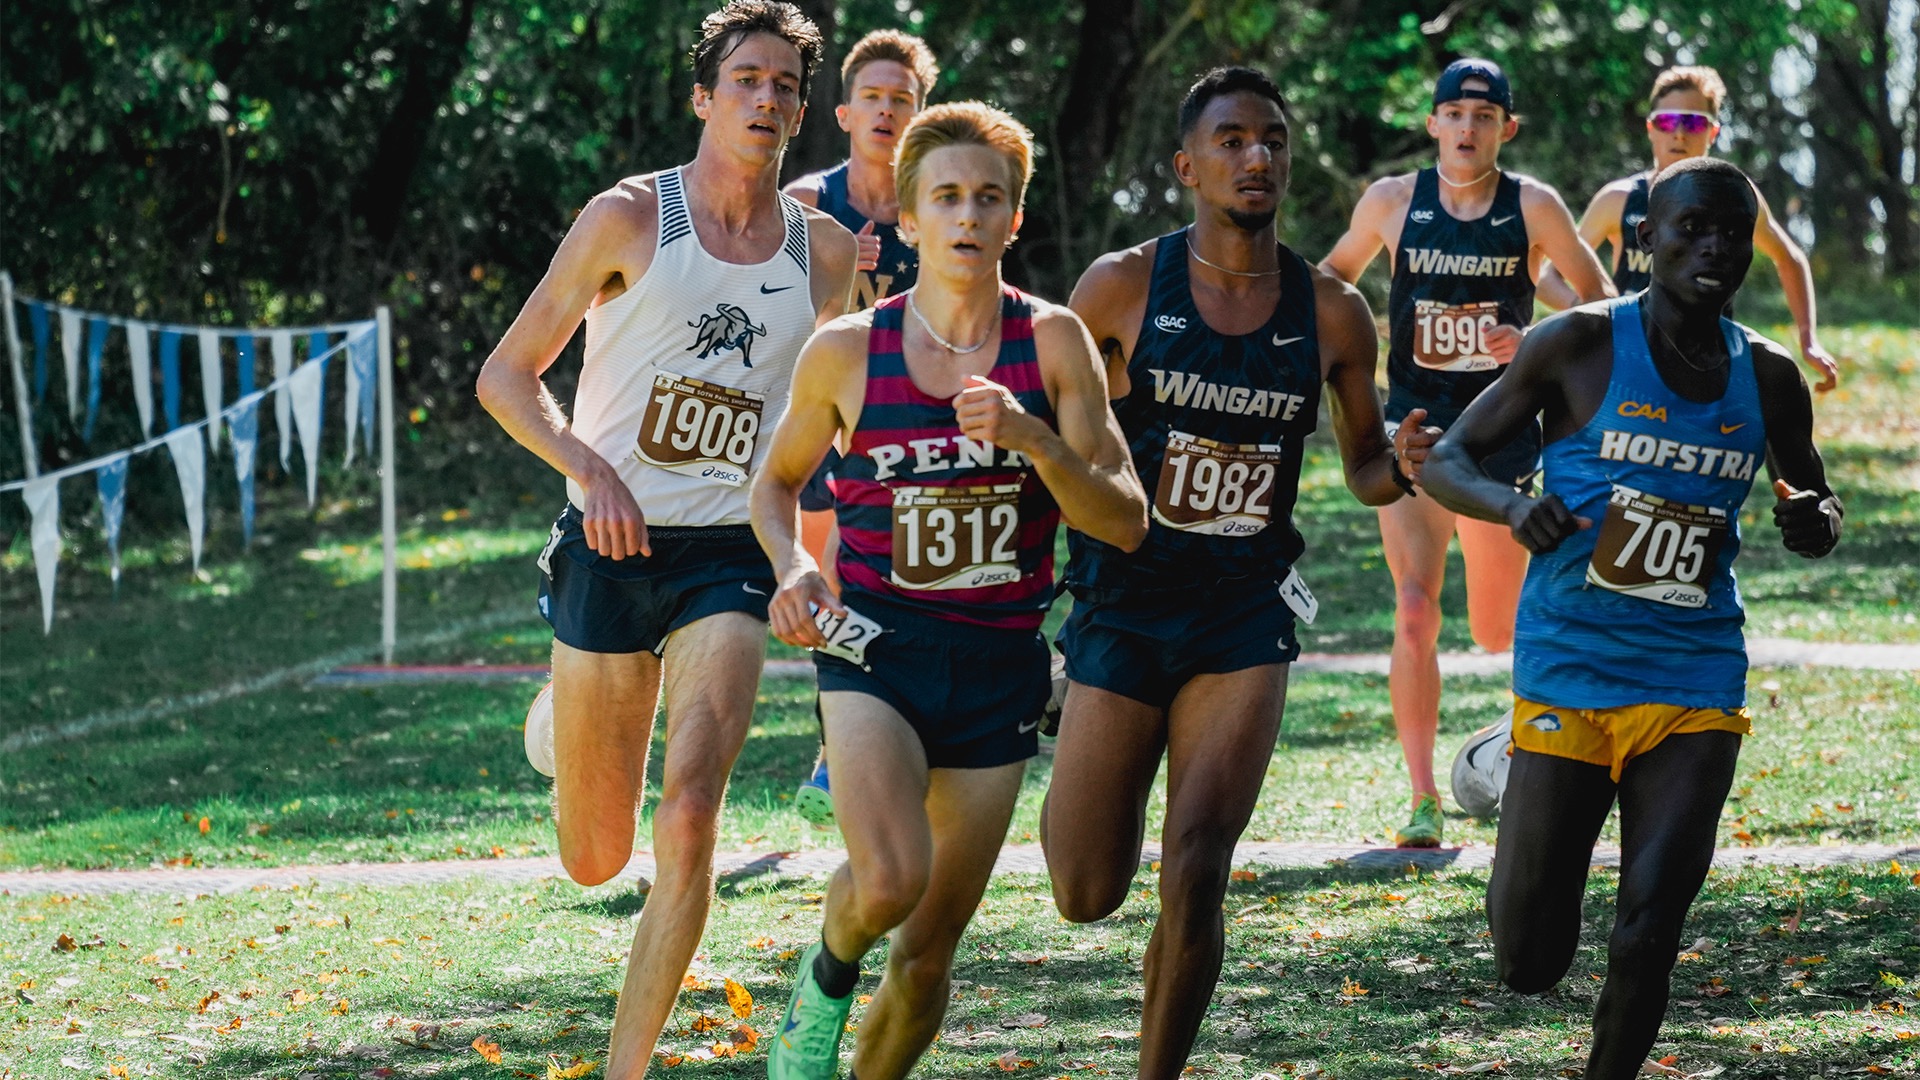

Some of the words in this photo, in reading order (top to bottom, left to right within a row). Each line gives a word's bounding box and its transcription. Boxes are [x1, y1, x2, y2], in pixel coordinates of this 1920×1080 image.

[1414, 210, 1434, 220] SAC
[1404, 248, 1520, 277] WINGATE
[1159, 315, 1187, 329] SAC
[714, 394, 730, 403] PAUL
[731, 398, 750, 407] SHORT
[1148, 368, 1306, 421] WINGATE
[1617, 401, 1667, 423] CAA
[652, 392, 759, 465] 1908
[1600, 430, 1756, 482] HOFSTRA
[713, 469, 739, 482] asics
[1168, 453, 1275, 515] 1982
[898, 504, 1019, 567] 1312
[1235, 522, 1260, 533] asics
[1613, 510, 1711, 583] 705
[1674, 592, 1699, 604] asics
[820, 611, 866, 652] 312
